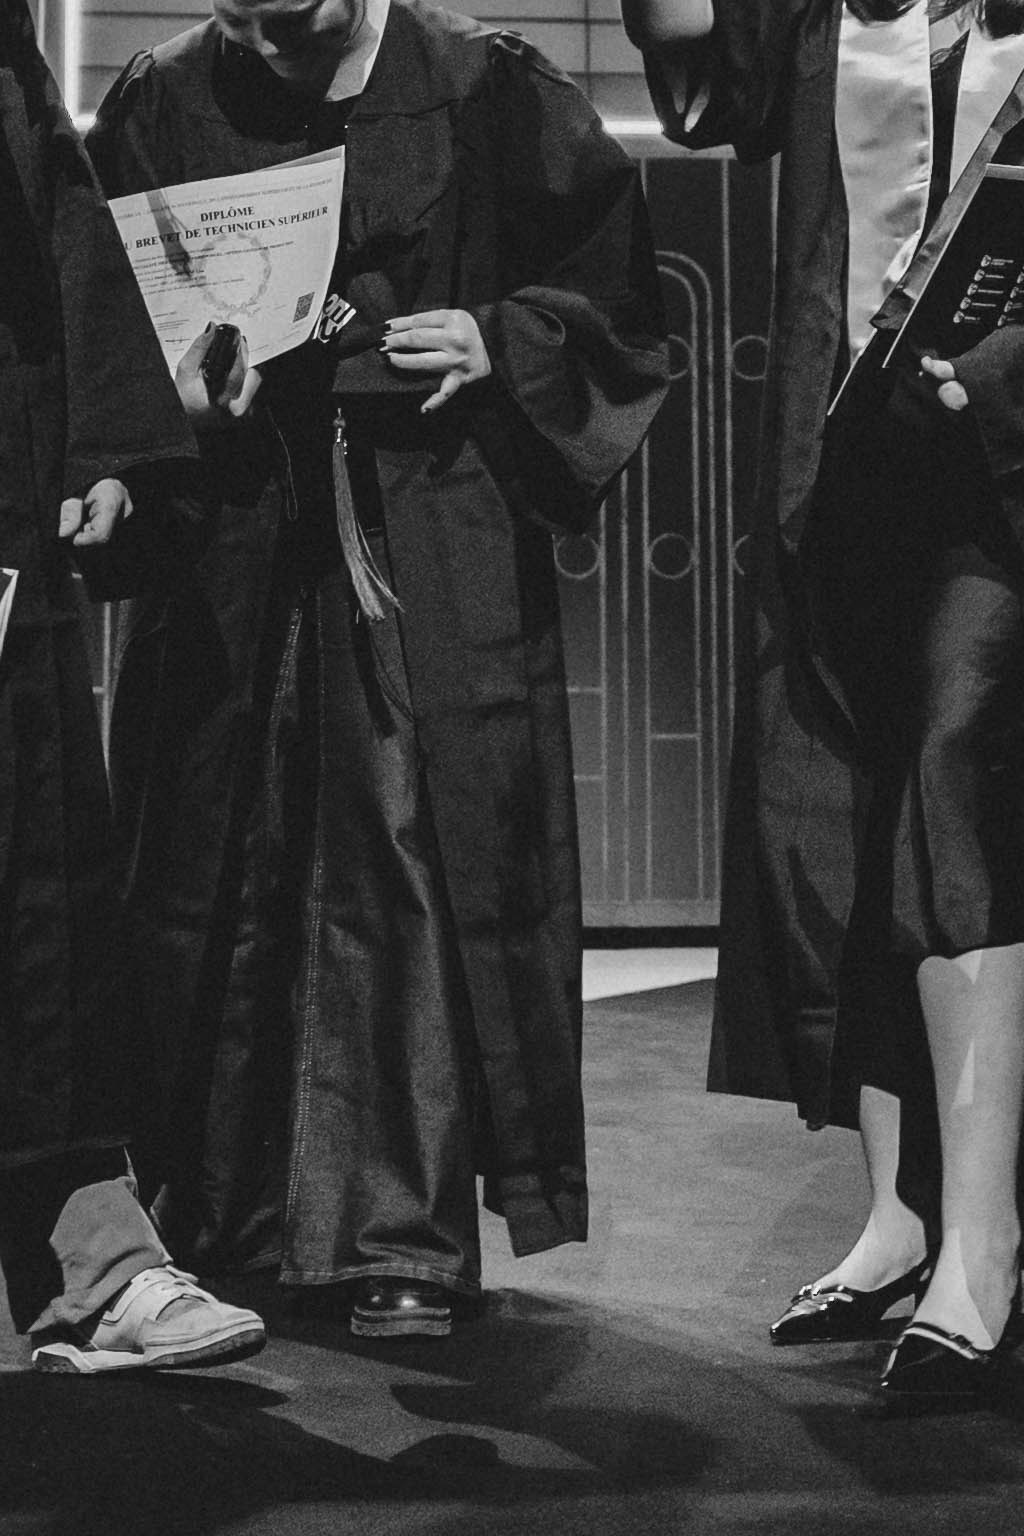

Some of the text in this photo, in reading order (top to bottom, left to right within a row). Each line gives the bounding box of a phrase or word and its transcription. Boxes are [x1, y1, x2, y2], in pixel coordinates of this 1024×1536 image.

[200, 206, 255, 223] DIPLÔME
[135, 231, 182, 248] BREVET
[185, 228, 201, 240] DE
[203, 218, 276, 237] TECHNICIEN
